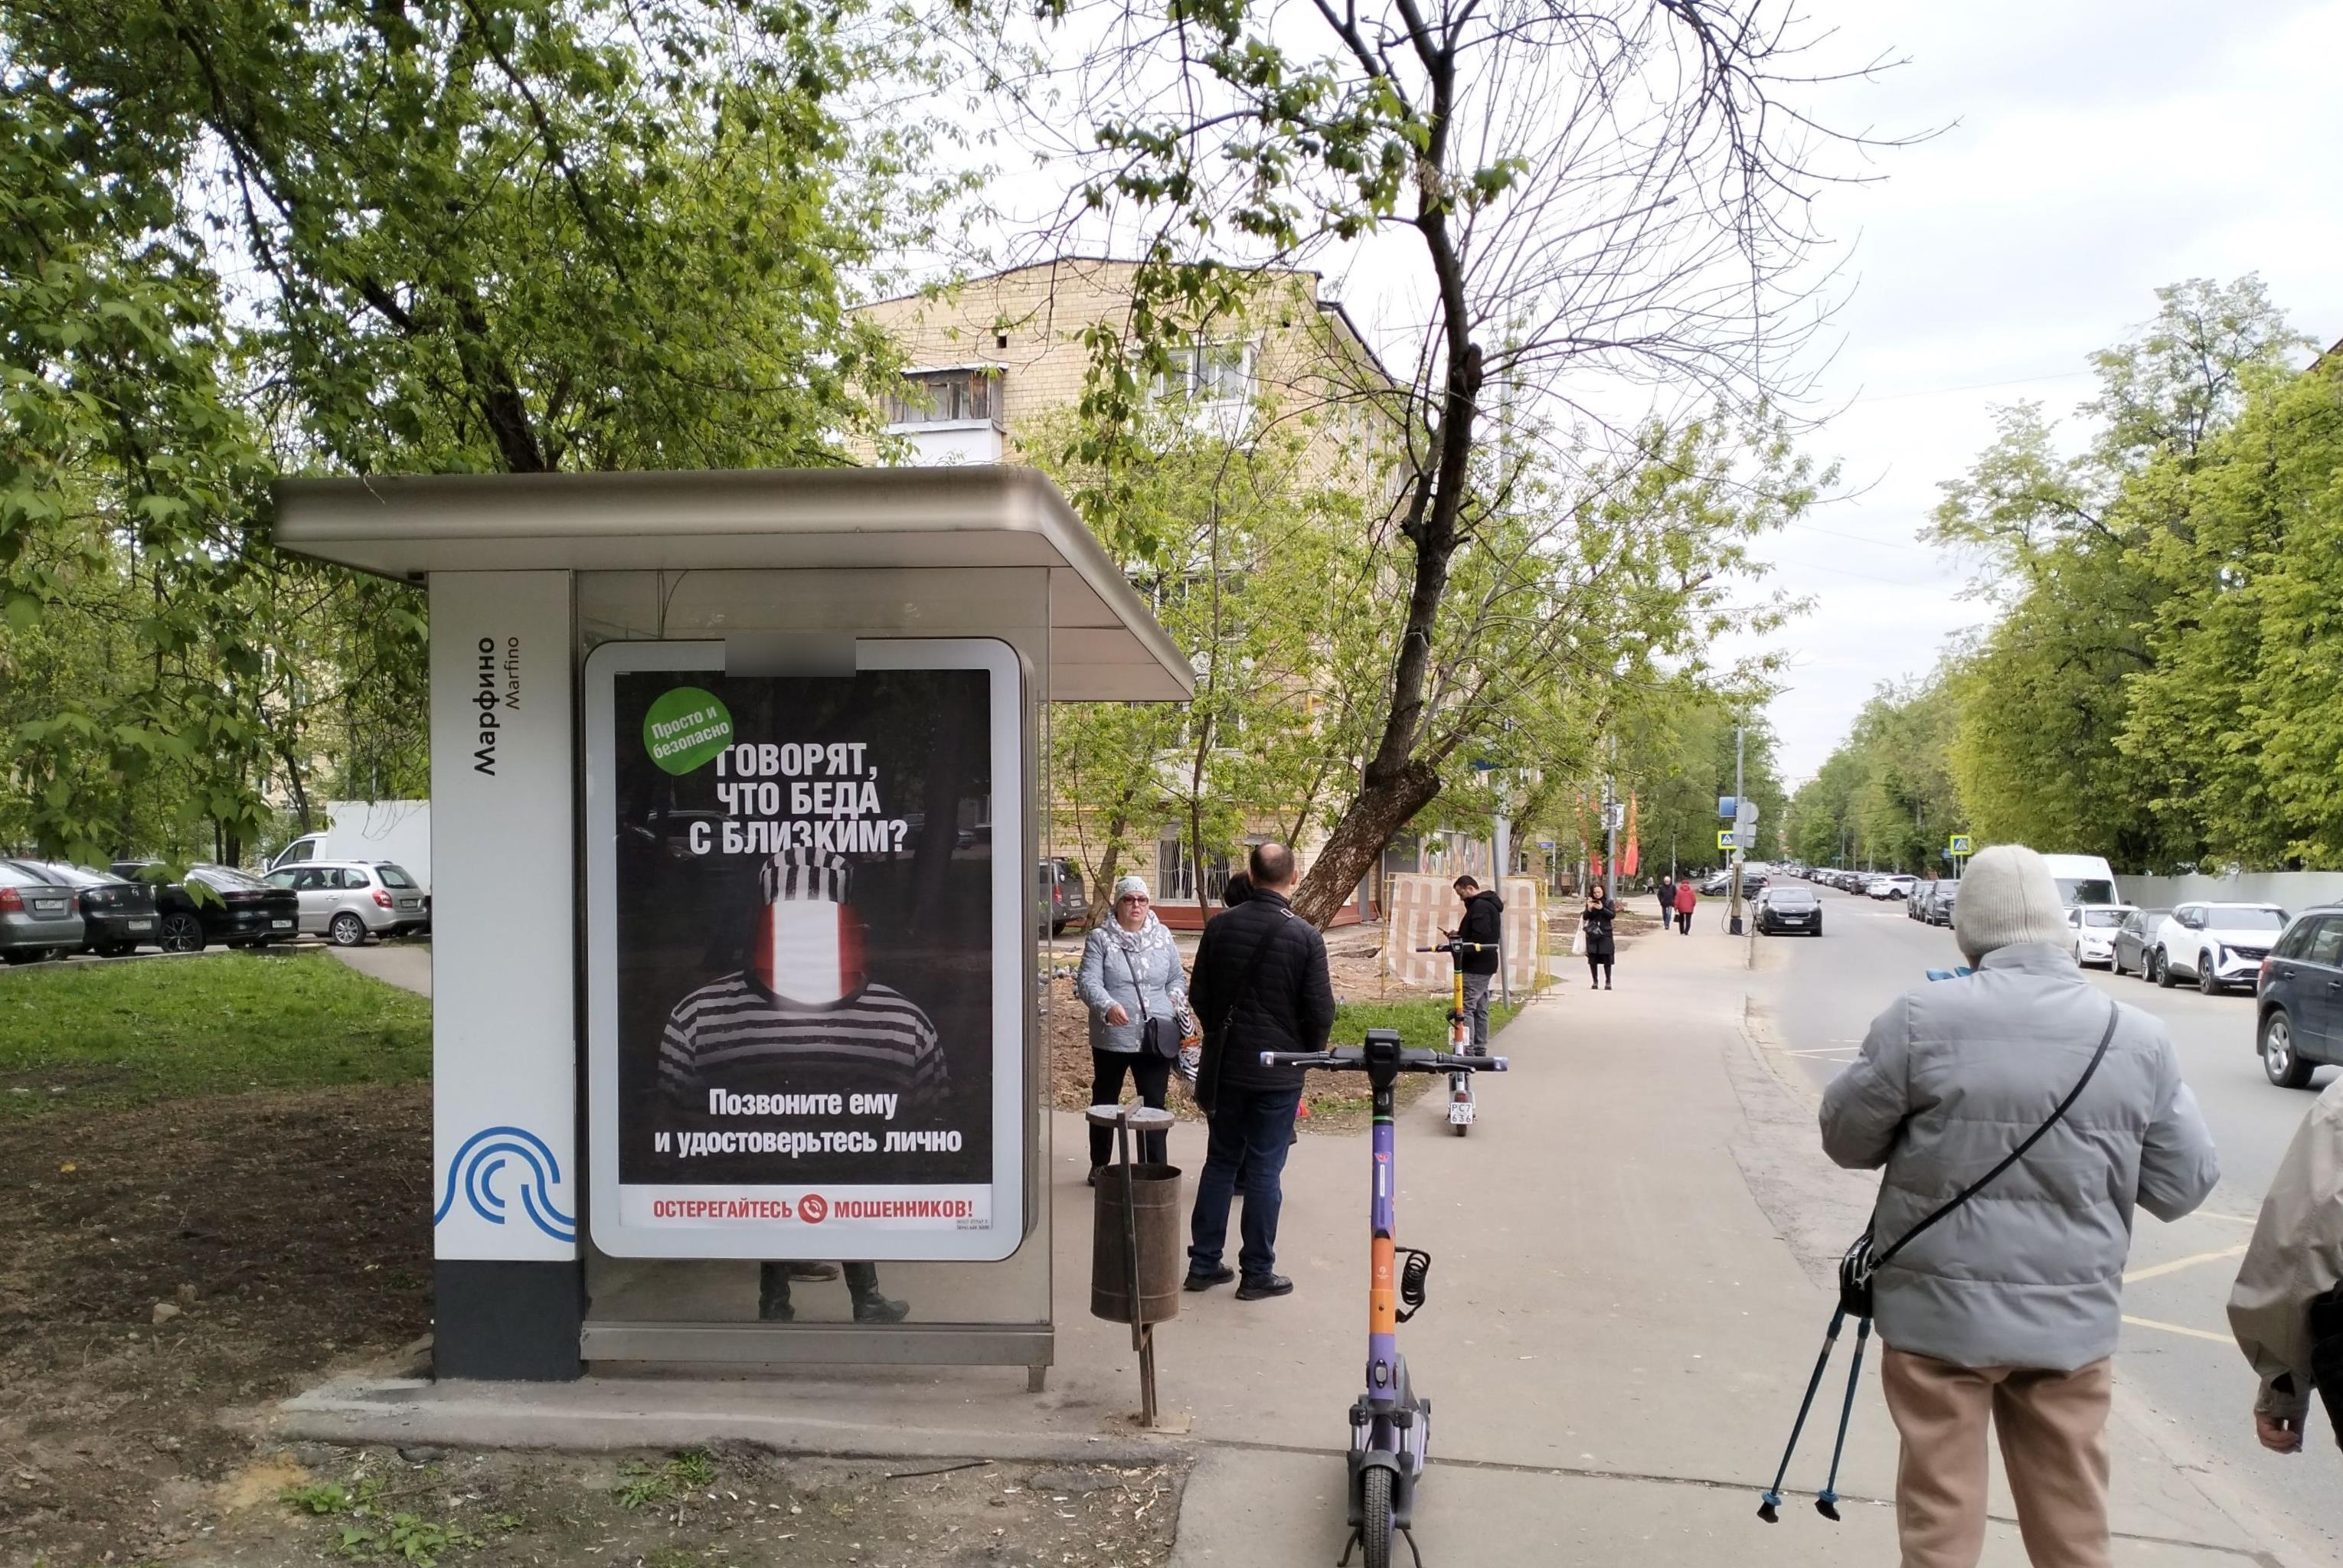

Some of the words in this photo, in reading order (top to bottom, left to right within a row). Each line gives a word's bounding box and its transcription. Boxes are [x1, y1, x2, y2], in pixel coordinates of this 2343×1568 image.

[504, 637, 520, 710] Marfino
[472, 637, 500, 776] Марфино
[652, 712, 704, 740] Просто
[652, 721, 730, 760] безопасно
[717, 743, 878, 779] ГОВОРЯТ,
[717, 782, 779, 815] ЧТО
[791, 781, 881, 820] БЕДА
[689, 821, 711, 854] С
[722, 819, 908, 854] БЛИЗКИМ?
[709, 1089, 842, 1116] Позвоните
[849, 1093, 897, 1119] ему
[1452, 1114, 1471, 1122] 636
[655, 1132, 670, 1152] и
[677, 1130, 877, 1158] удостоверьтесь
[883, 1130, 962, 1152] лично
[653, 1197, 792, 1218] ОСТЕРЕГАЙТЕСЬ
[834, 1200, 973, 1218] МОШЕННИКОВ!
